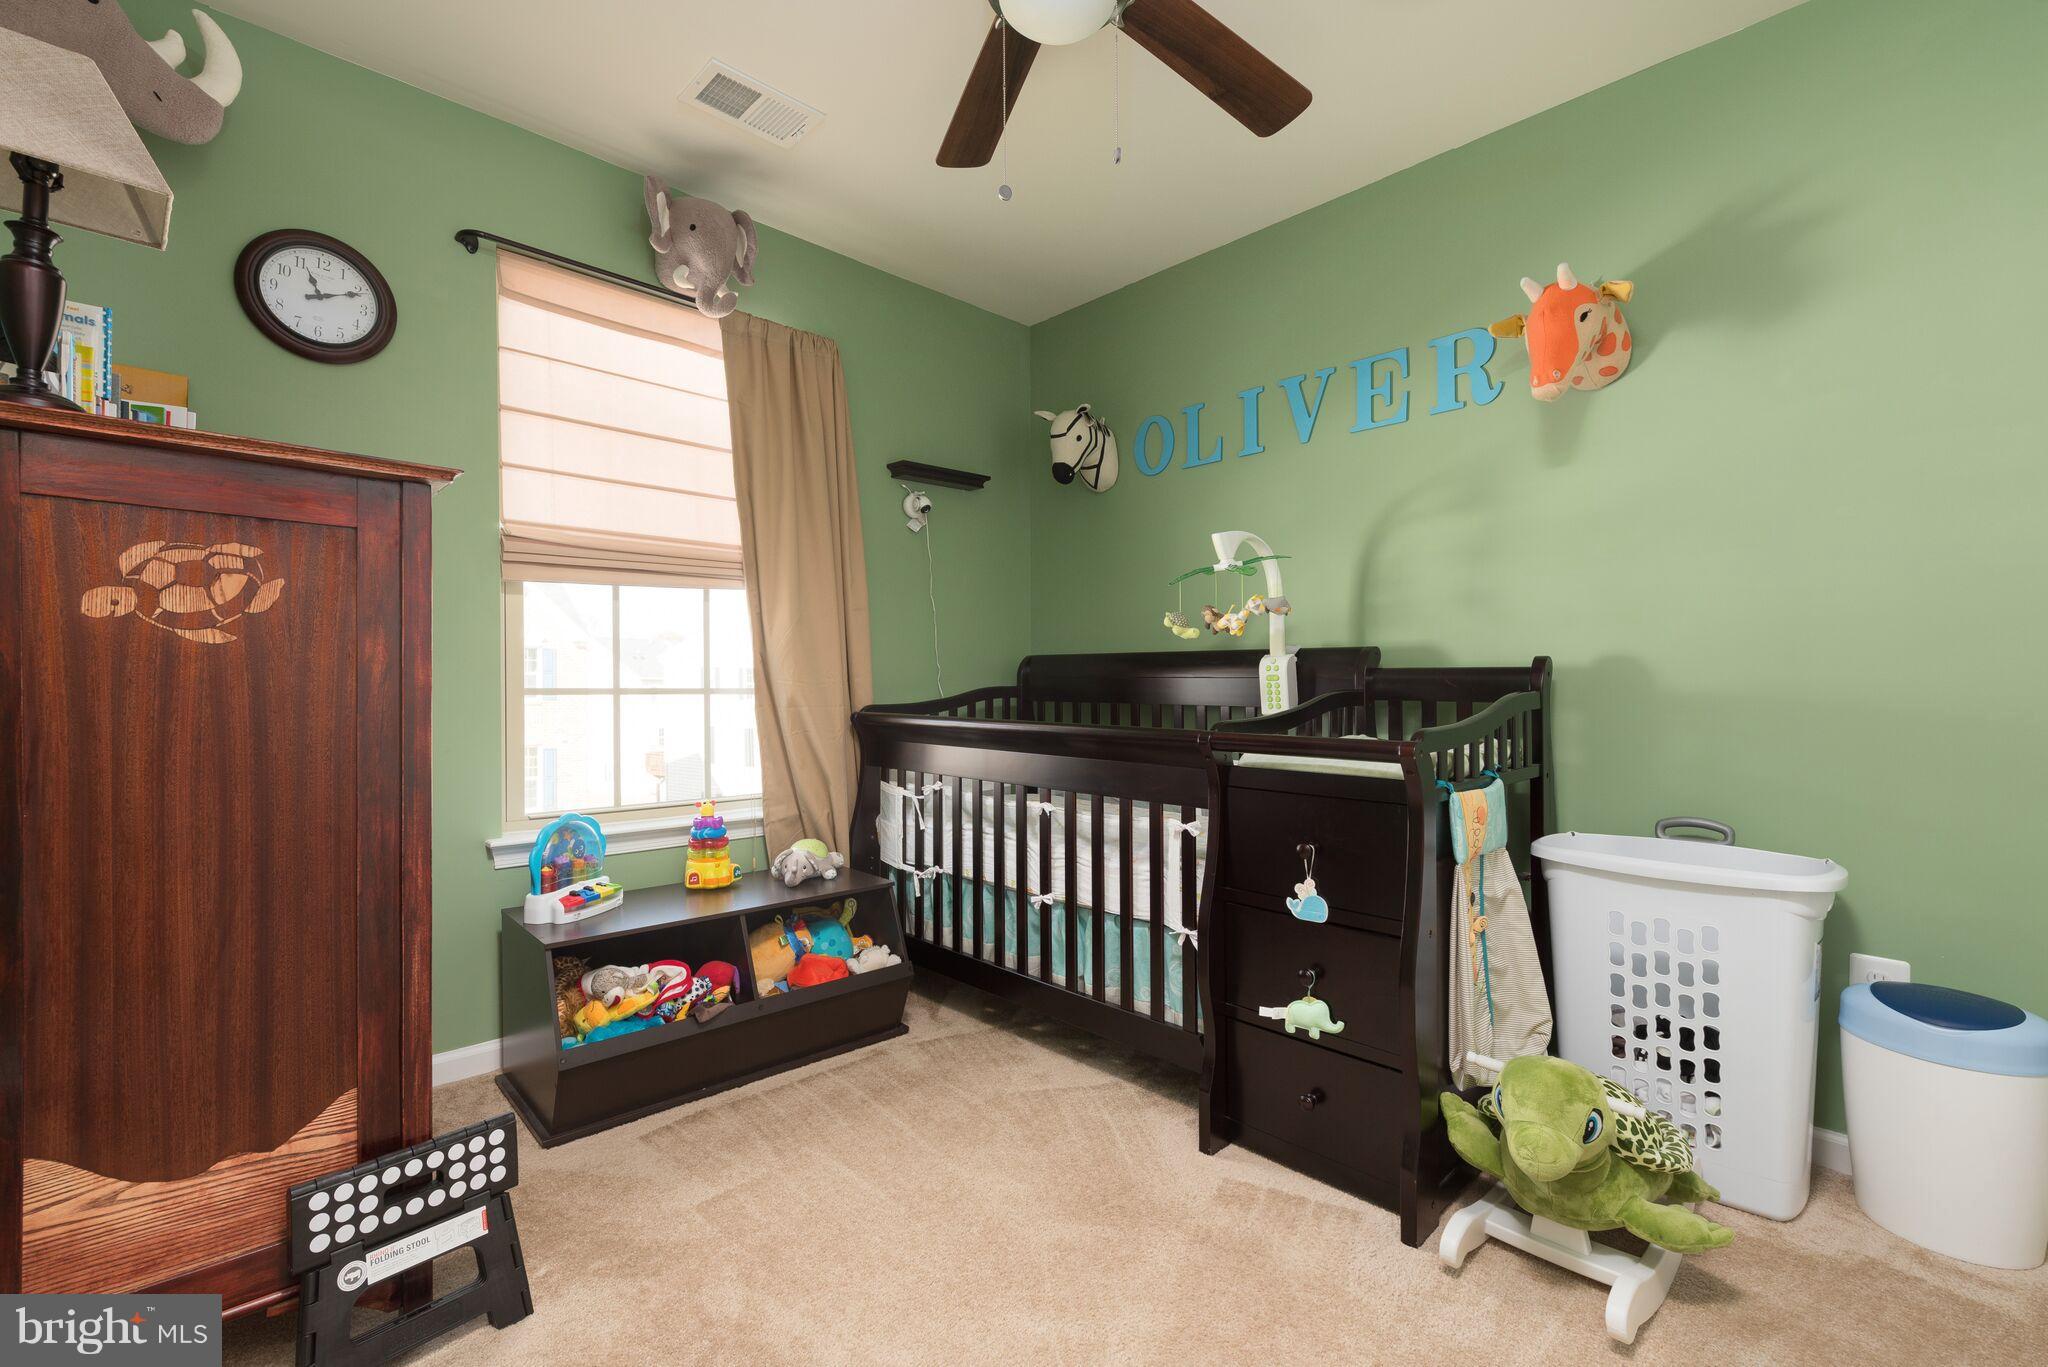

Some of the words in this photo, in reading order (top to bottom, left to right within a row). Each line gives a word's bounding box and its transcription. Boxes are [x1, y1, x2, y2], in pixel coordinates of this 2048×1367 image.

[295, 255, 306, 270] 11
[316, 257, 331, 272] 12
[278, 263, 292, 278] 10
[269, 278, 278, 290] 9
[275, 299, 284, 310] 8
[360, 304, 368, 317] 3
[294, 314, 303, 327] 7
[352, 319, 360, 331] 4
[314, 326, 323, 338] 6
[336, 327, 345, 339] 5
[1133, 326, 1505, 477] OLIVER
[369, 1247, 405, 1267] FOLDING
[405, 1236, 431, 1252] STOOL
